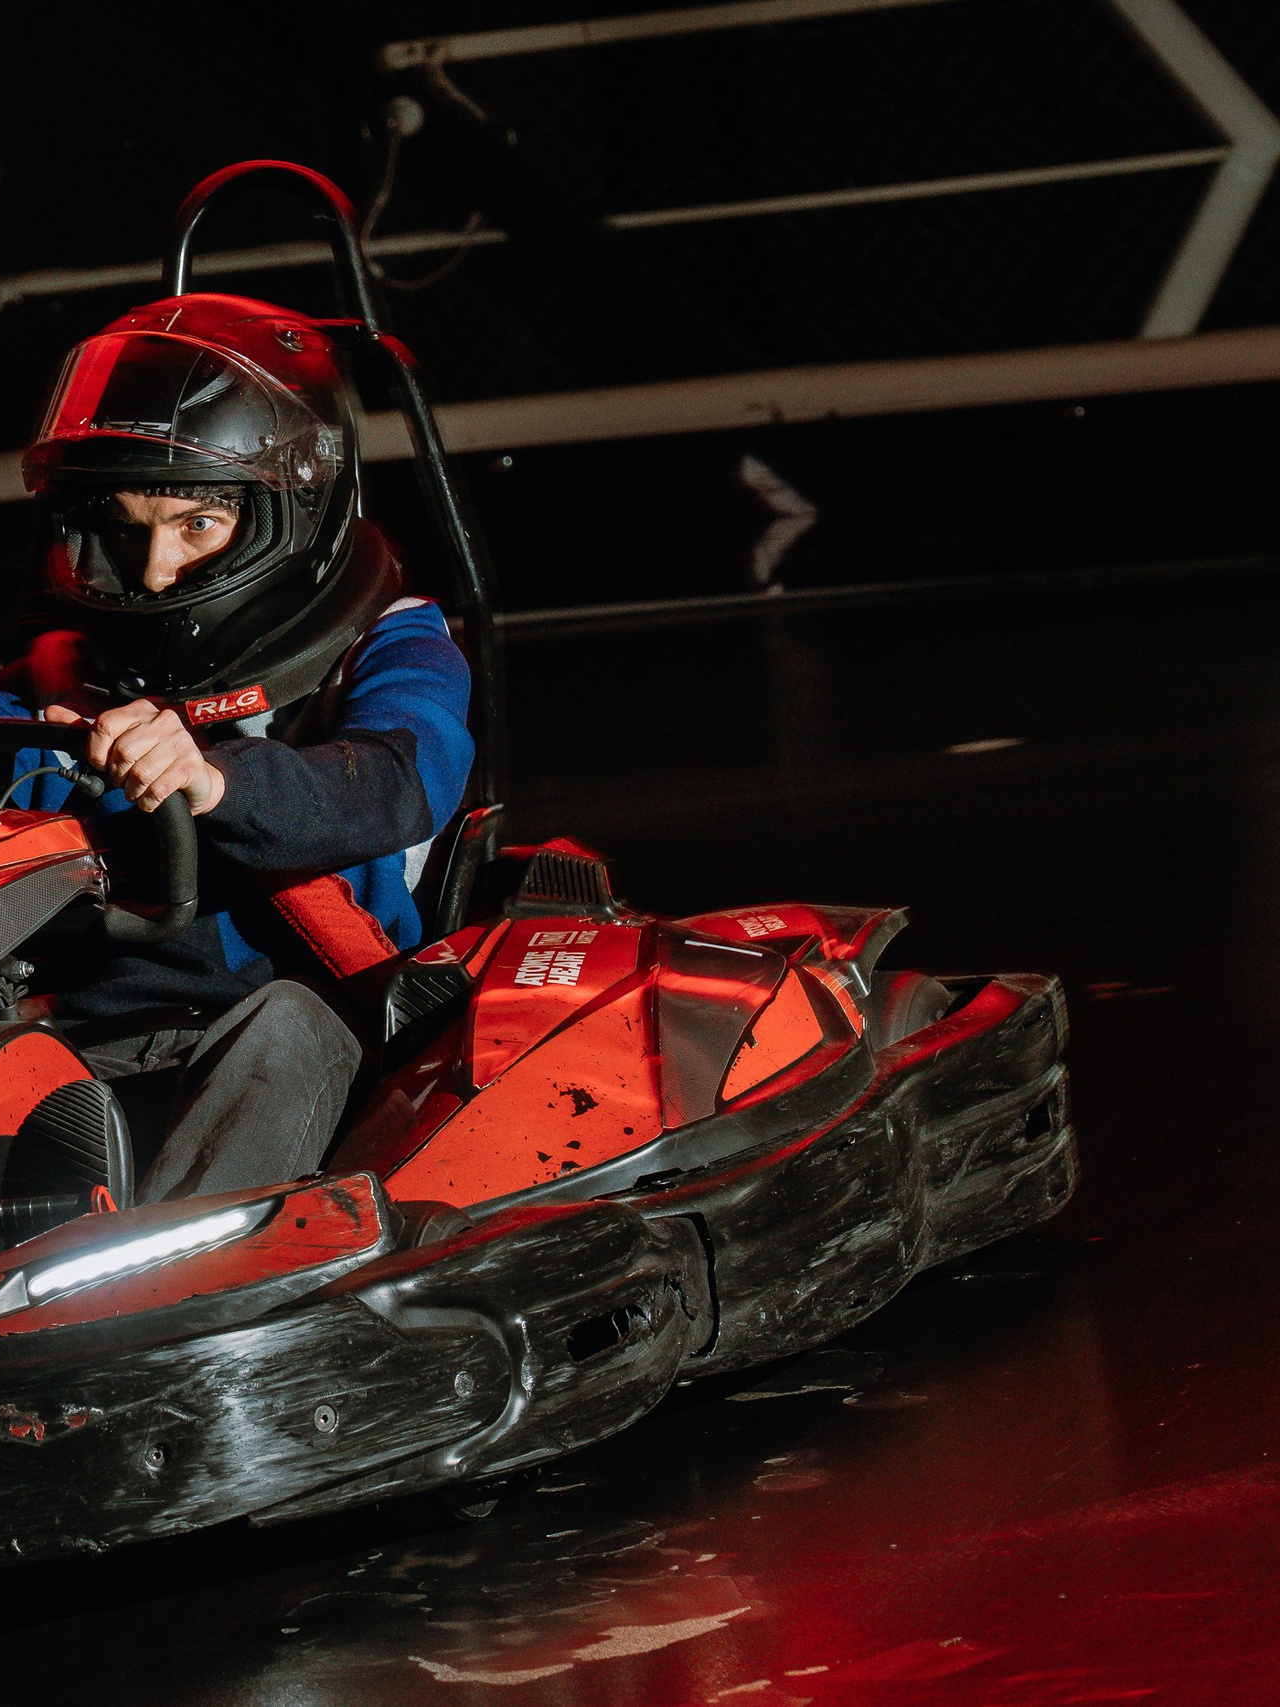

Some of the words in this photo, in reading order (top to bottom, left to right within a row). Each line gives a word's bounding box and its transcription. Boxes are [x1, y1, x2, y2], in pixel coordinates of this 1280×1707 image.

[195, 691, 258, 716] RLG
[514, 951, 555, 986] ATOMIC
[547, 951, 586, 986] HEART
